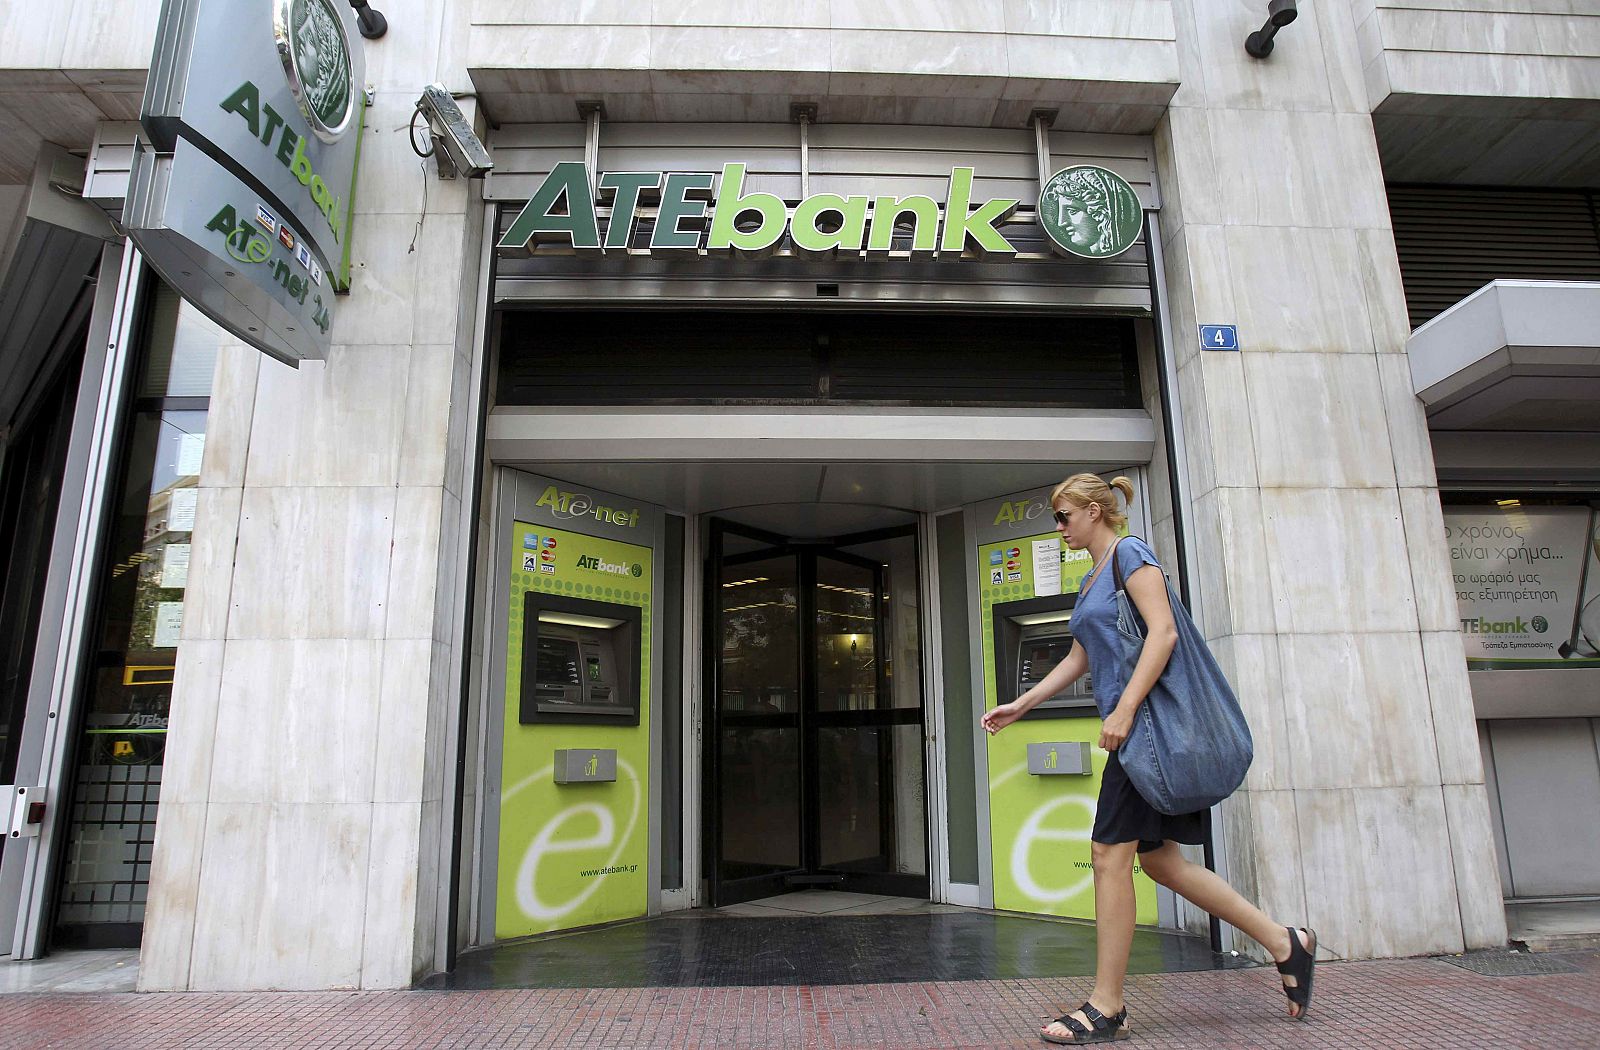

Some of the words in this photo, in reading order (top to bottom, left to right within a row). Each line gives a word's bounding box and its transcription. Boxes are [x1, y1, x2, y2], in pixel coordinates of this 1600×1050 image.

[497, 161, 1020, 253] ATEbank
[1214, 330, 1224, 346] 4
[1458, 521, 1525, 543] χρόνος
[1451, 542, 1489, 560] είναι
[576, 554, 630, 576] ATEbank
[1469, 570, 1515, 587] ωράριό
[1519, 573, 1541, 587] μας
[1479, 587, 1559, 604] εξυπηρέτηση
[580, 864, 638, 878] www.atebank.gr
